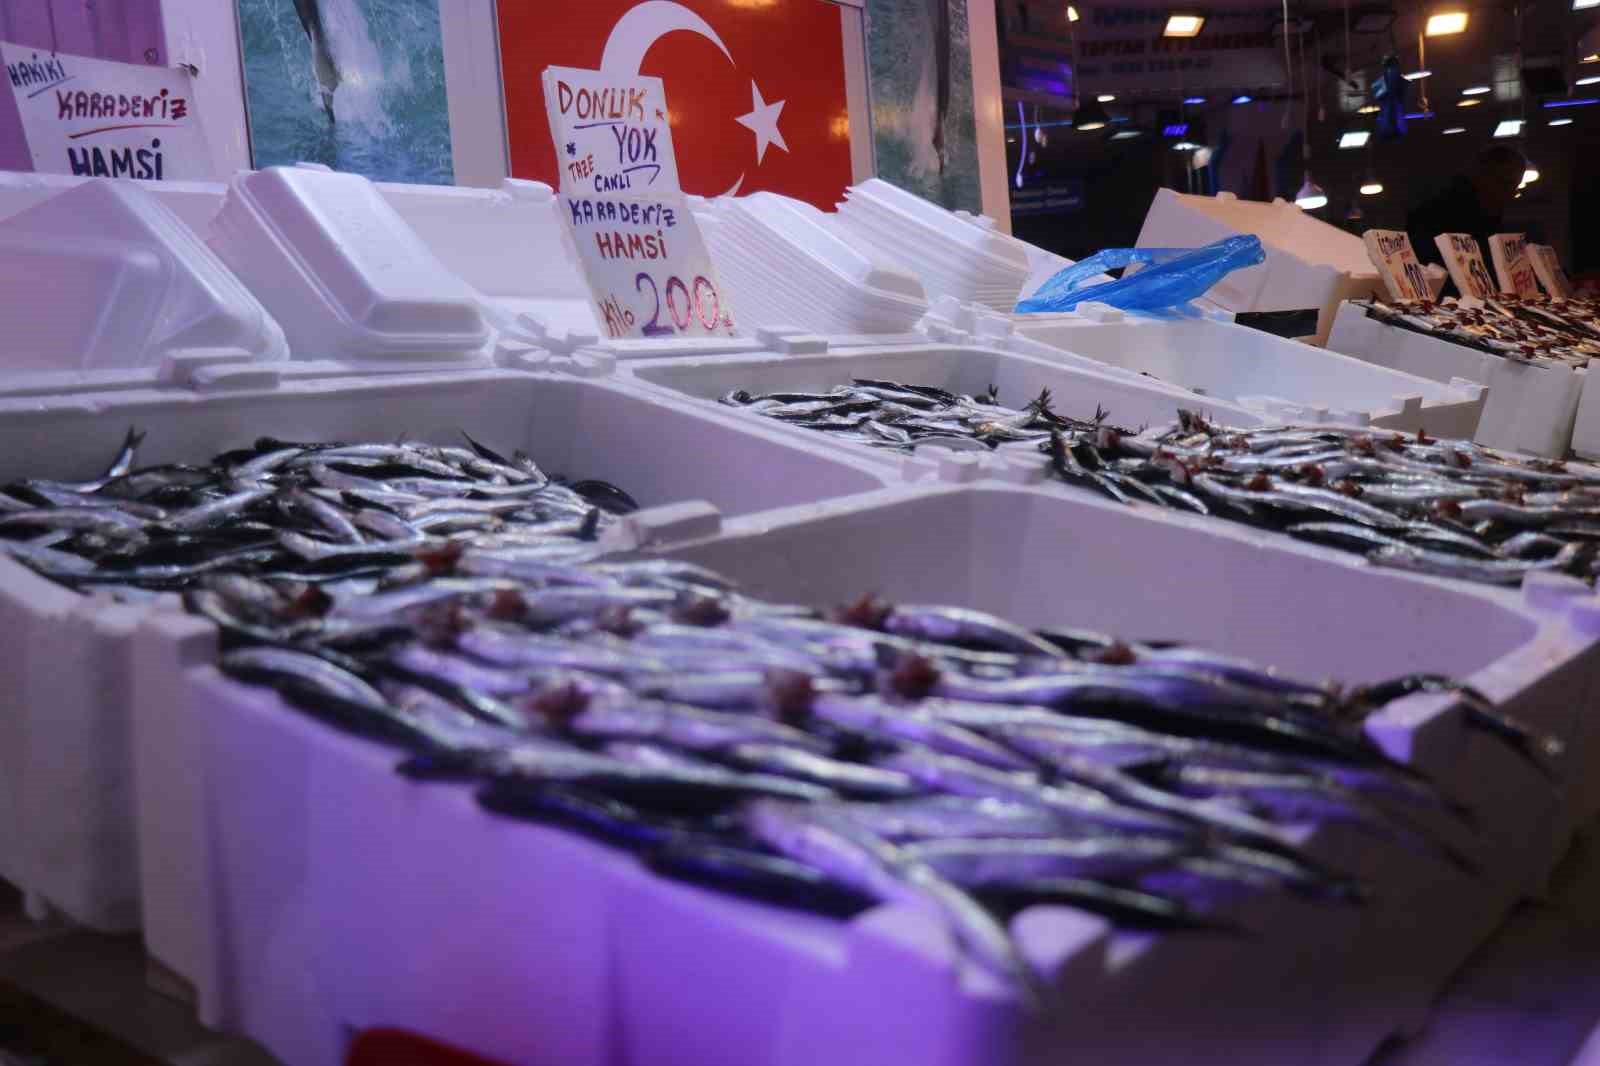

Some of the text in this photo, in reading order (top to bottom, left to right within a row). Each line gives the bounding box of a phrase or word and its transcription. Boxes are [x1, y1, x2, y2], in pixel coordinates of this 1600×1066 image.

[56, 88, 187, 120] KARADENİZ
[557, 80, 648, 121] DONUK
[67, 137, 163, 180] HAMSİ
[612, 126, 657, 164] YOK
[568, 154, 594, 183] TAZE
[594, 173, 631, 192] CANLI
[568, 198, 677, 227] KARADENİZ
[595, 229, 667, 259] HAMSİ
